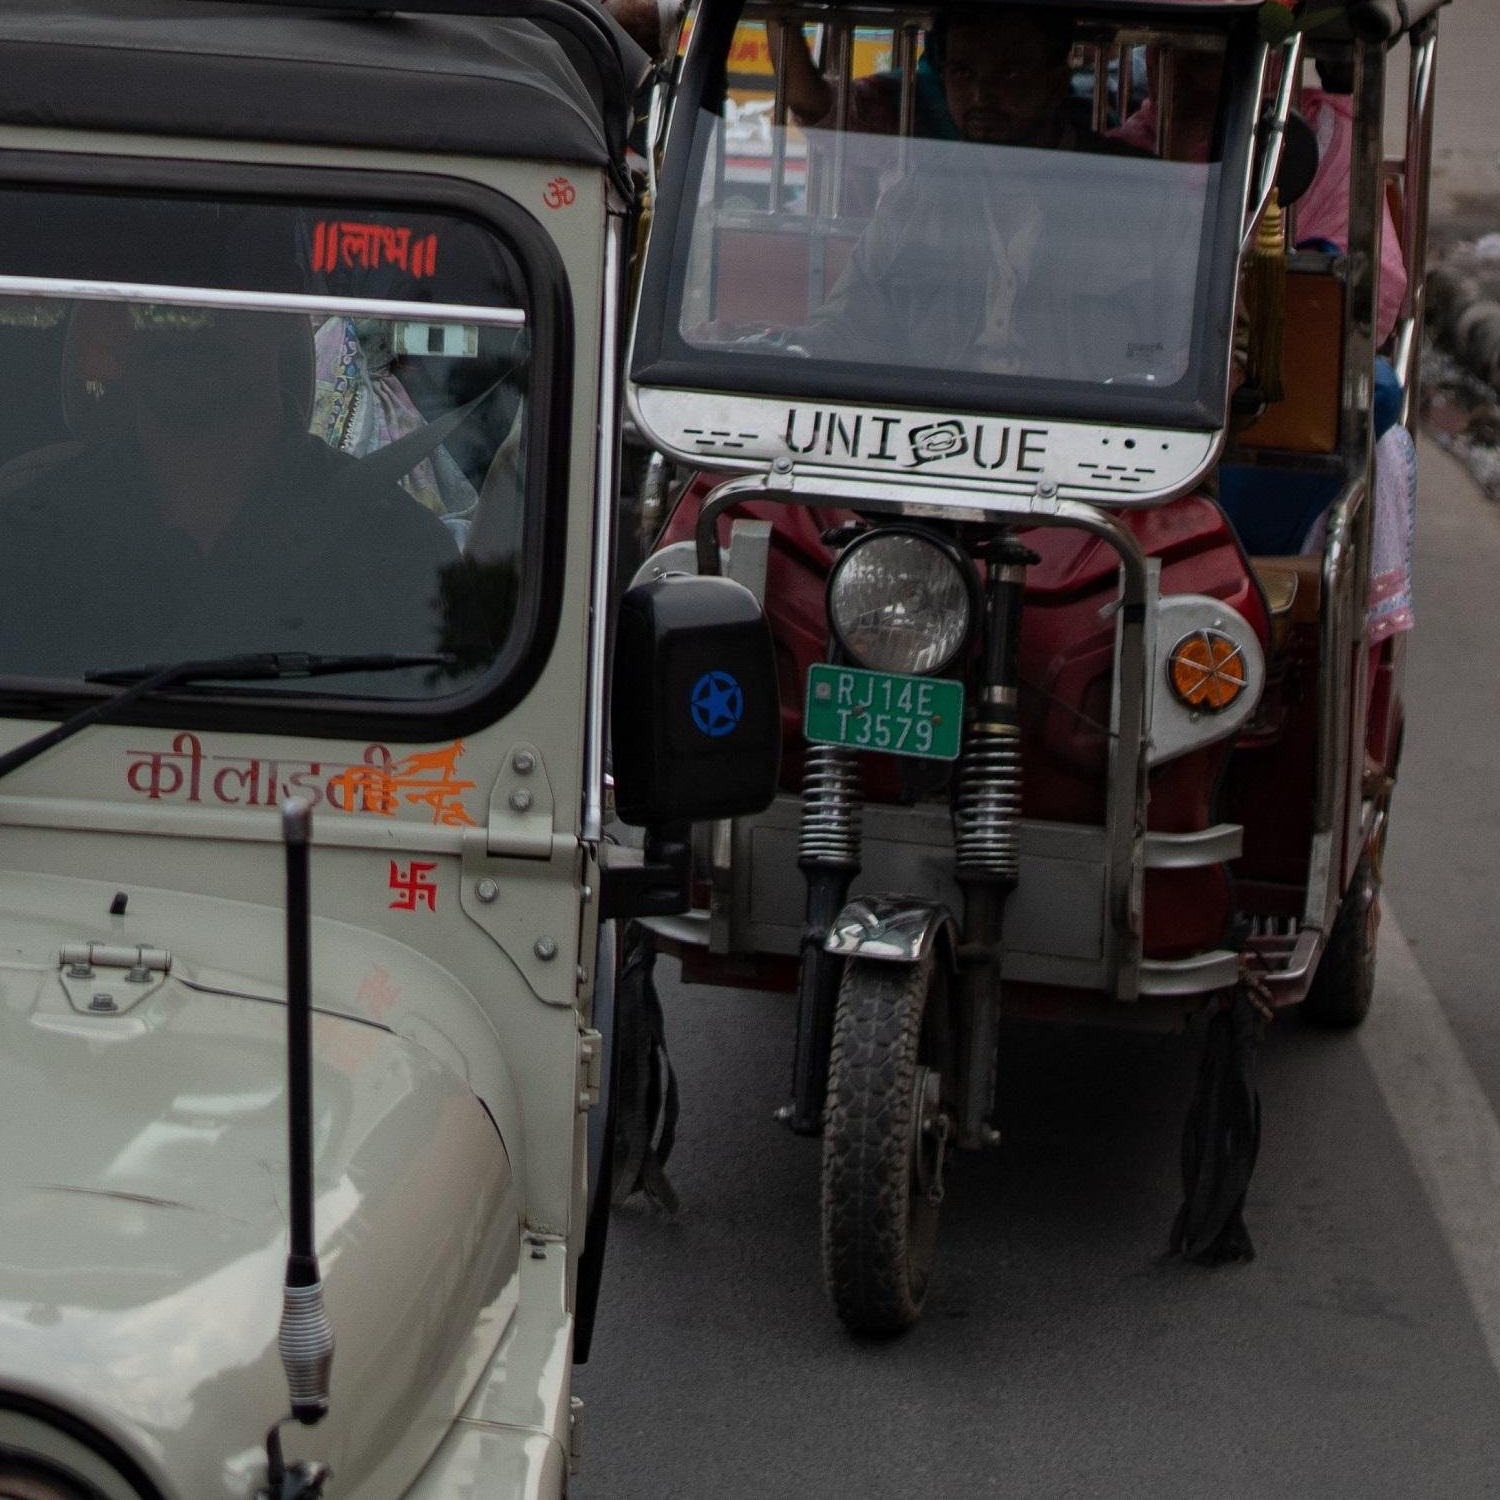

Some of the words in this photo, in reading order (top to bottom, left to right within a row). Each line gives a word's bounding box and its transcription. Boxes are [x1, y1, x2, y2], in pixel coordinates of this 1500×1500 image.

[785, 409, 1048, 473] UNIQUE
[837, 673, 934, 716] RJ14E
[836, 708, 933, 752] T3579
[127, 732, 208, 801] की
